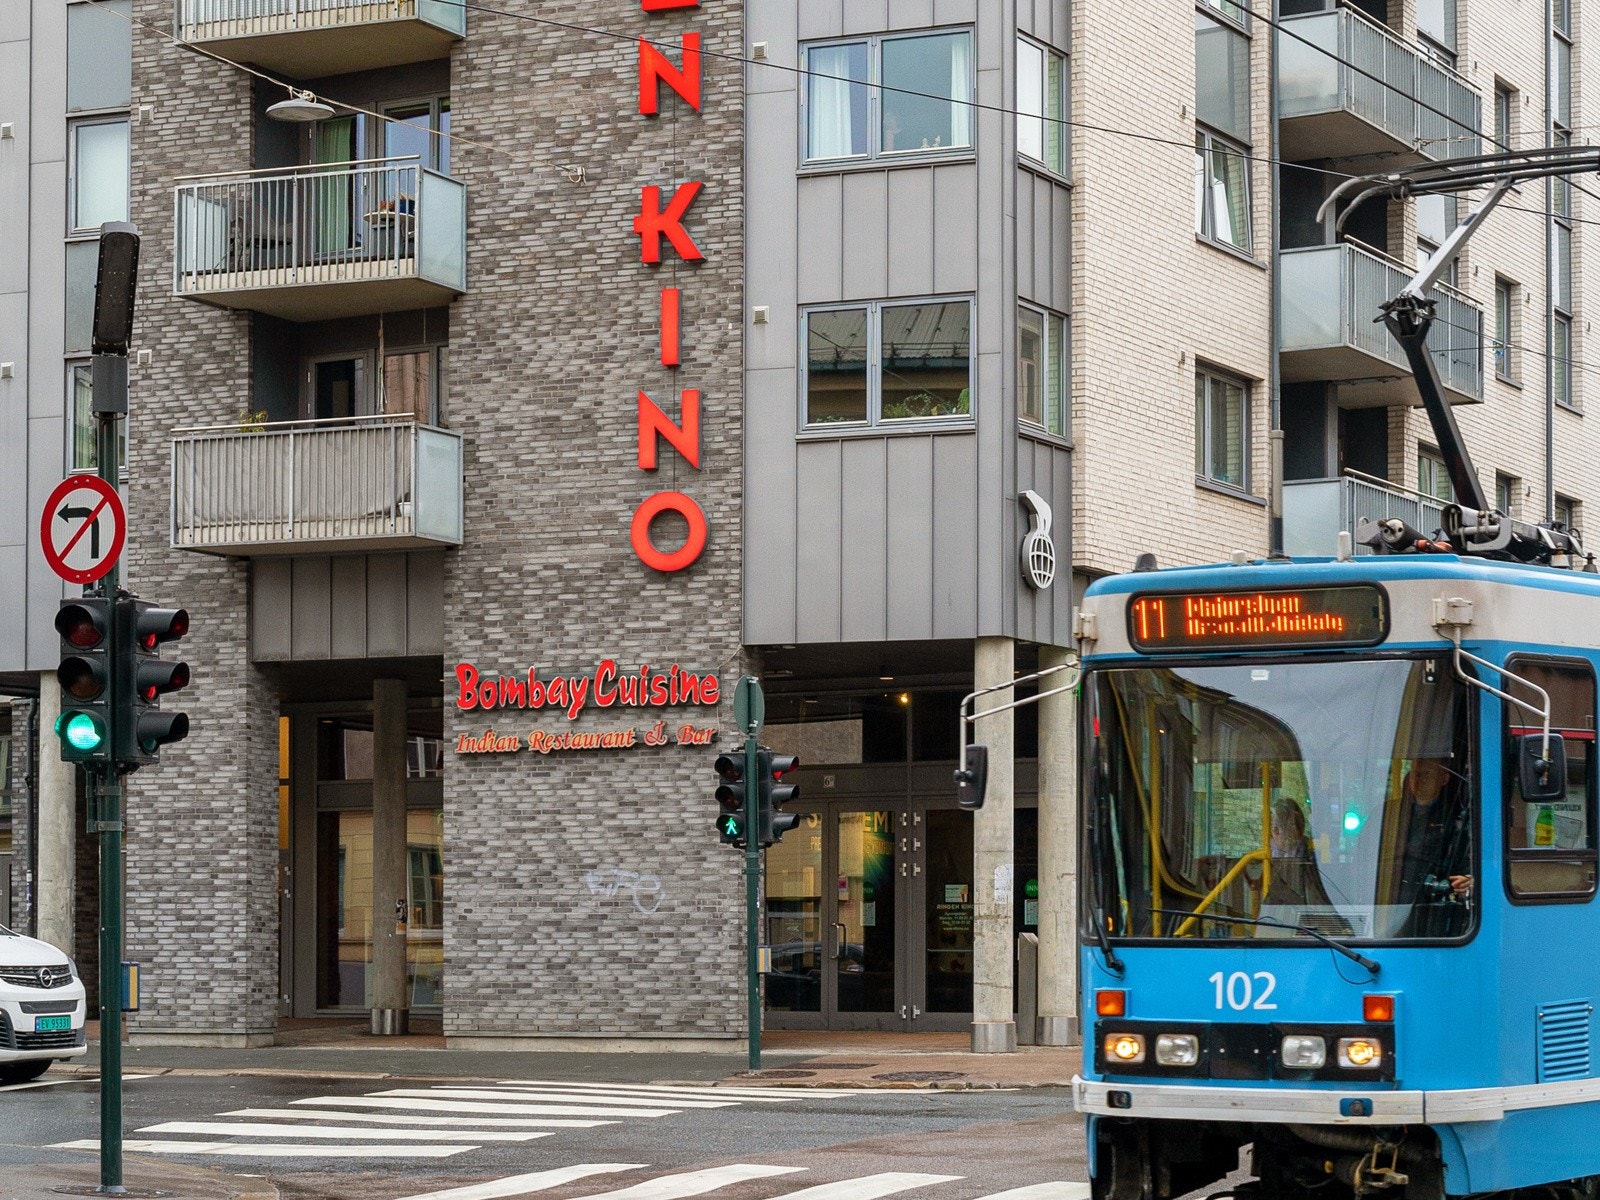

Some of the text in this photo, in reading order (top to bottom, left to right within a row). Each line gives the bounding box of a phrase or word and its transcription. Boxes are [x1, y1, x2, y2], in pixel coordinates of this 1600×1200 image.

[630, 182, 706, 571] KINO
[1133, 599, 1165, 639] 11
[455, 658, 720, 720] Bombay Cuisine
[455, 730, 520, 755] Indian
[528, 727, 636, 754] Restaurant
[676, 723, 717, 745] Bar
[1208, 971, 1278, 1011] 102
[41, 1018, 70, 1029] EV 95331
